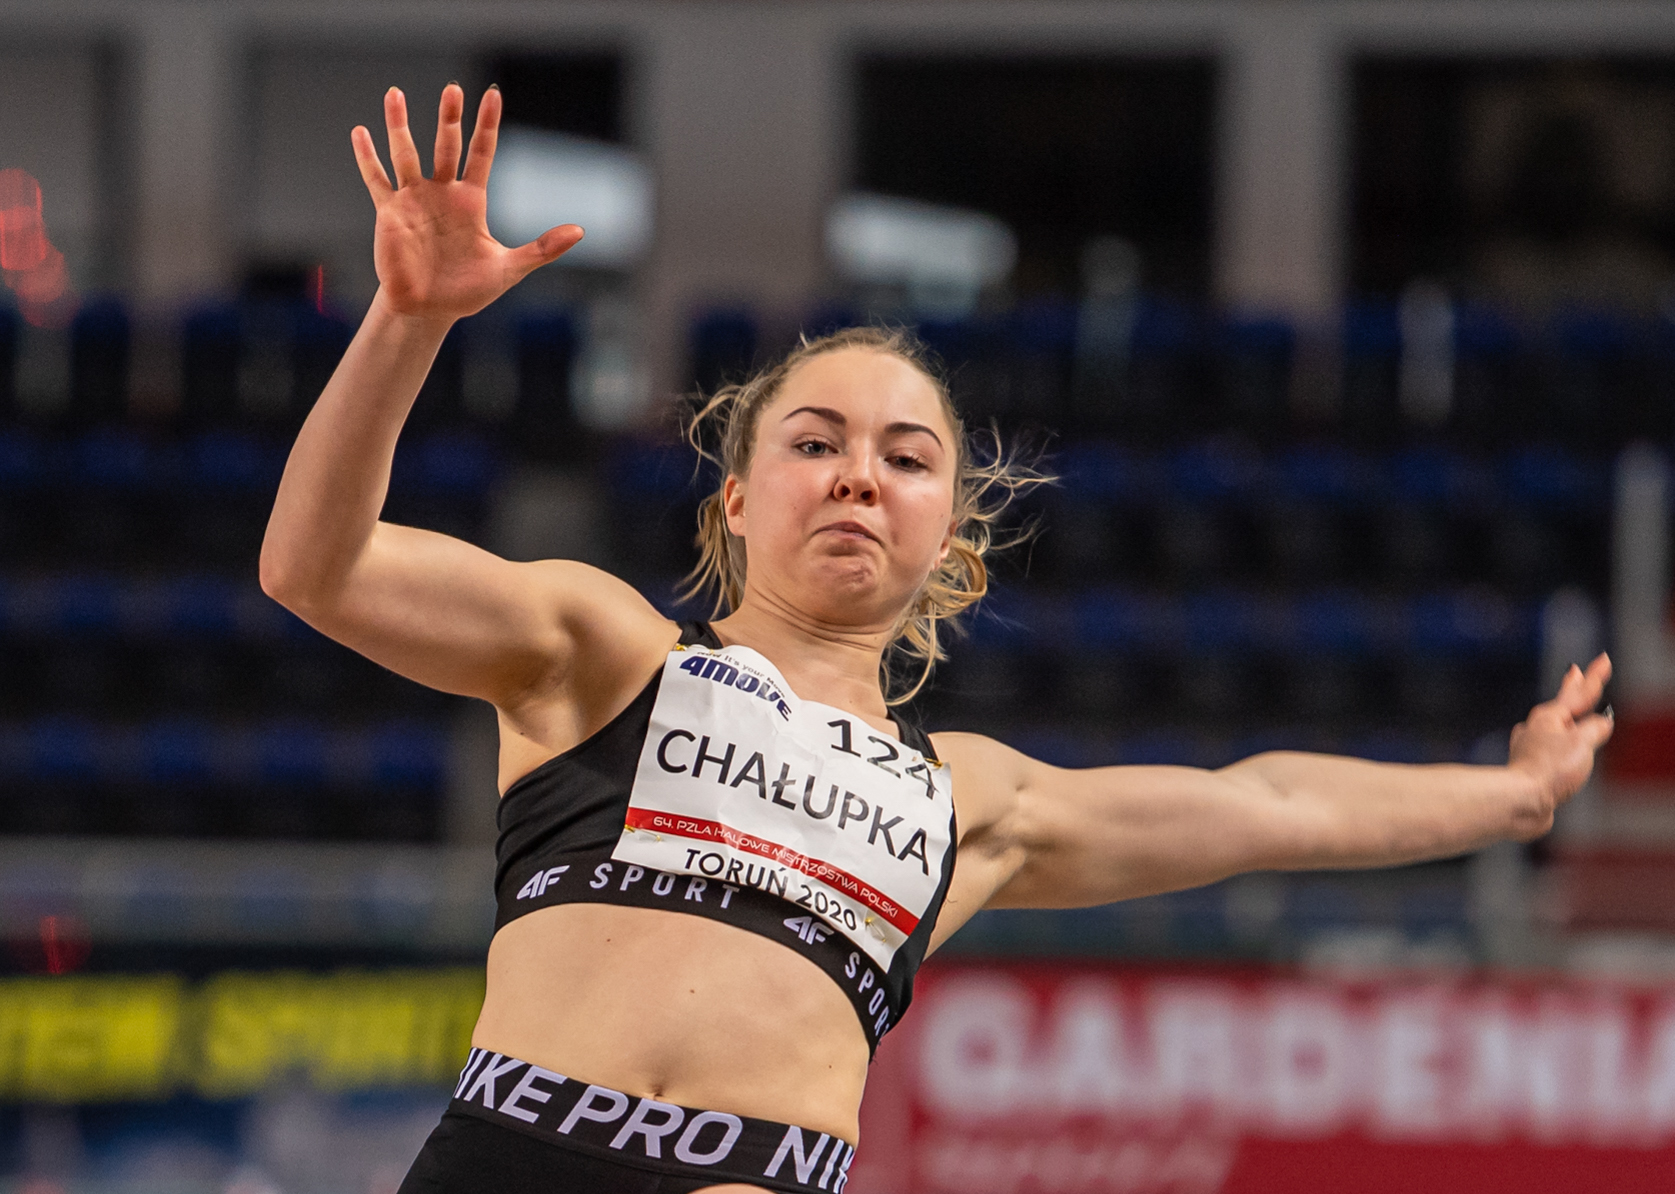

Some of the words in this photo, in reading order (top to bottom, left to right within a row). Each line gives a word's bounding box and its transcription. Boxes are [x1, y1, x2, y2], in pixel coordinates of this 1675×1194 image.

[827, 719, 940, 800] 124
[656, 729, 930, 876] CHAŁUPKA
[589, 863, 741, 909] SPORT
[653, 816, 674, 829] 64.
[676, 820, 712, 835] PZLA
[714, 827, 770, 853] HALOWE
[772, 848, 858, 894] MISTRZOSTWA
[860, 887, 899, 918] POLSKI
[684, 848, 789, 898] TORUŃ
[795, 884, 857, 931] 2020
[557, 1084, 744, 1165] PRO
